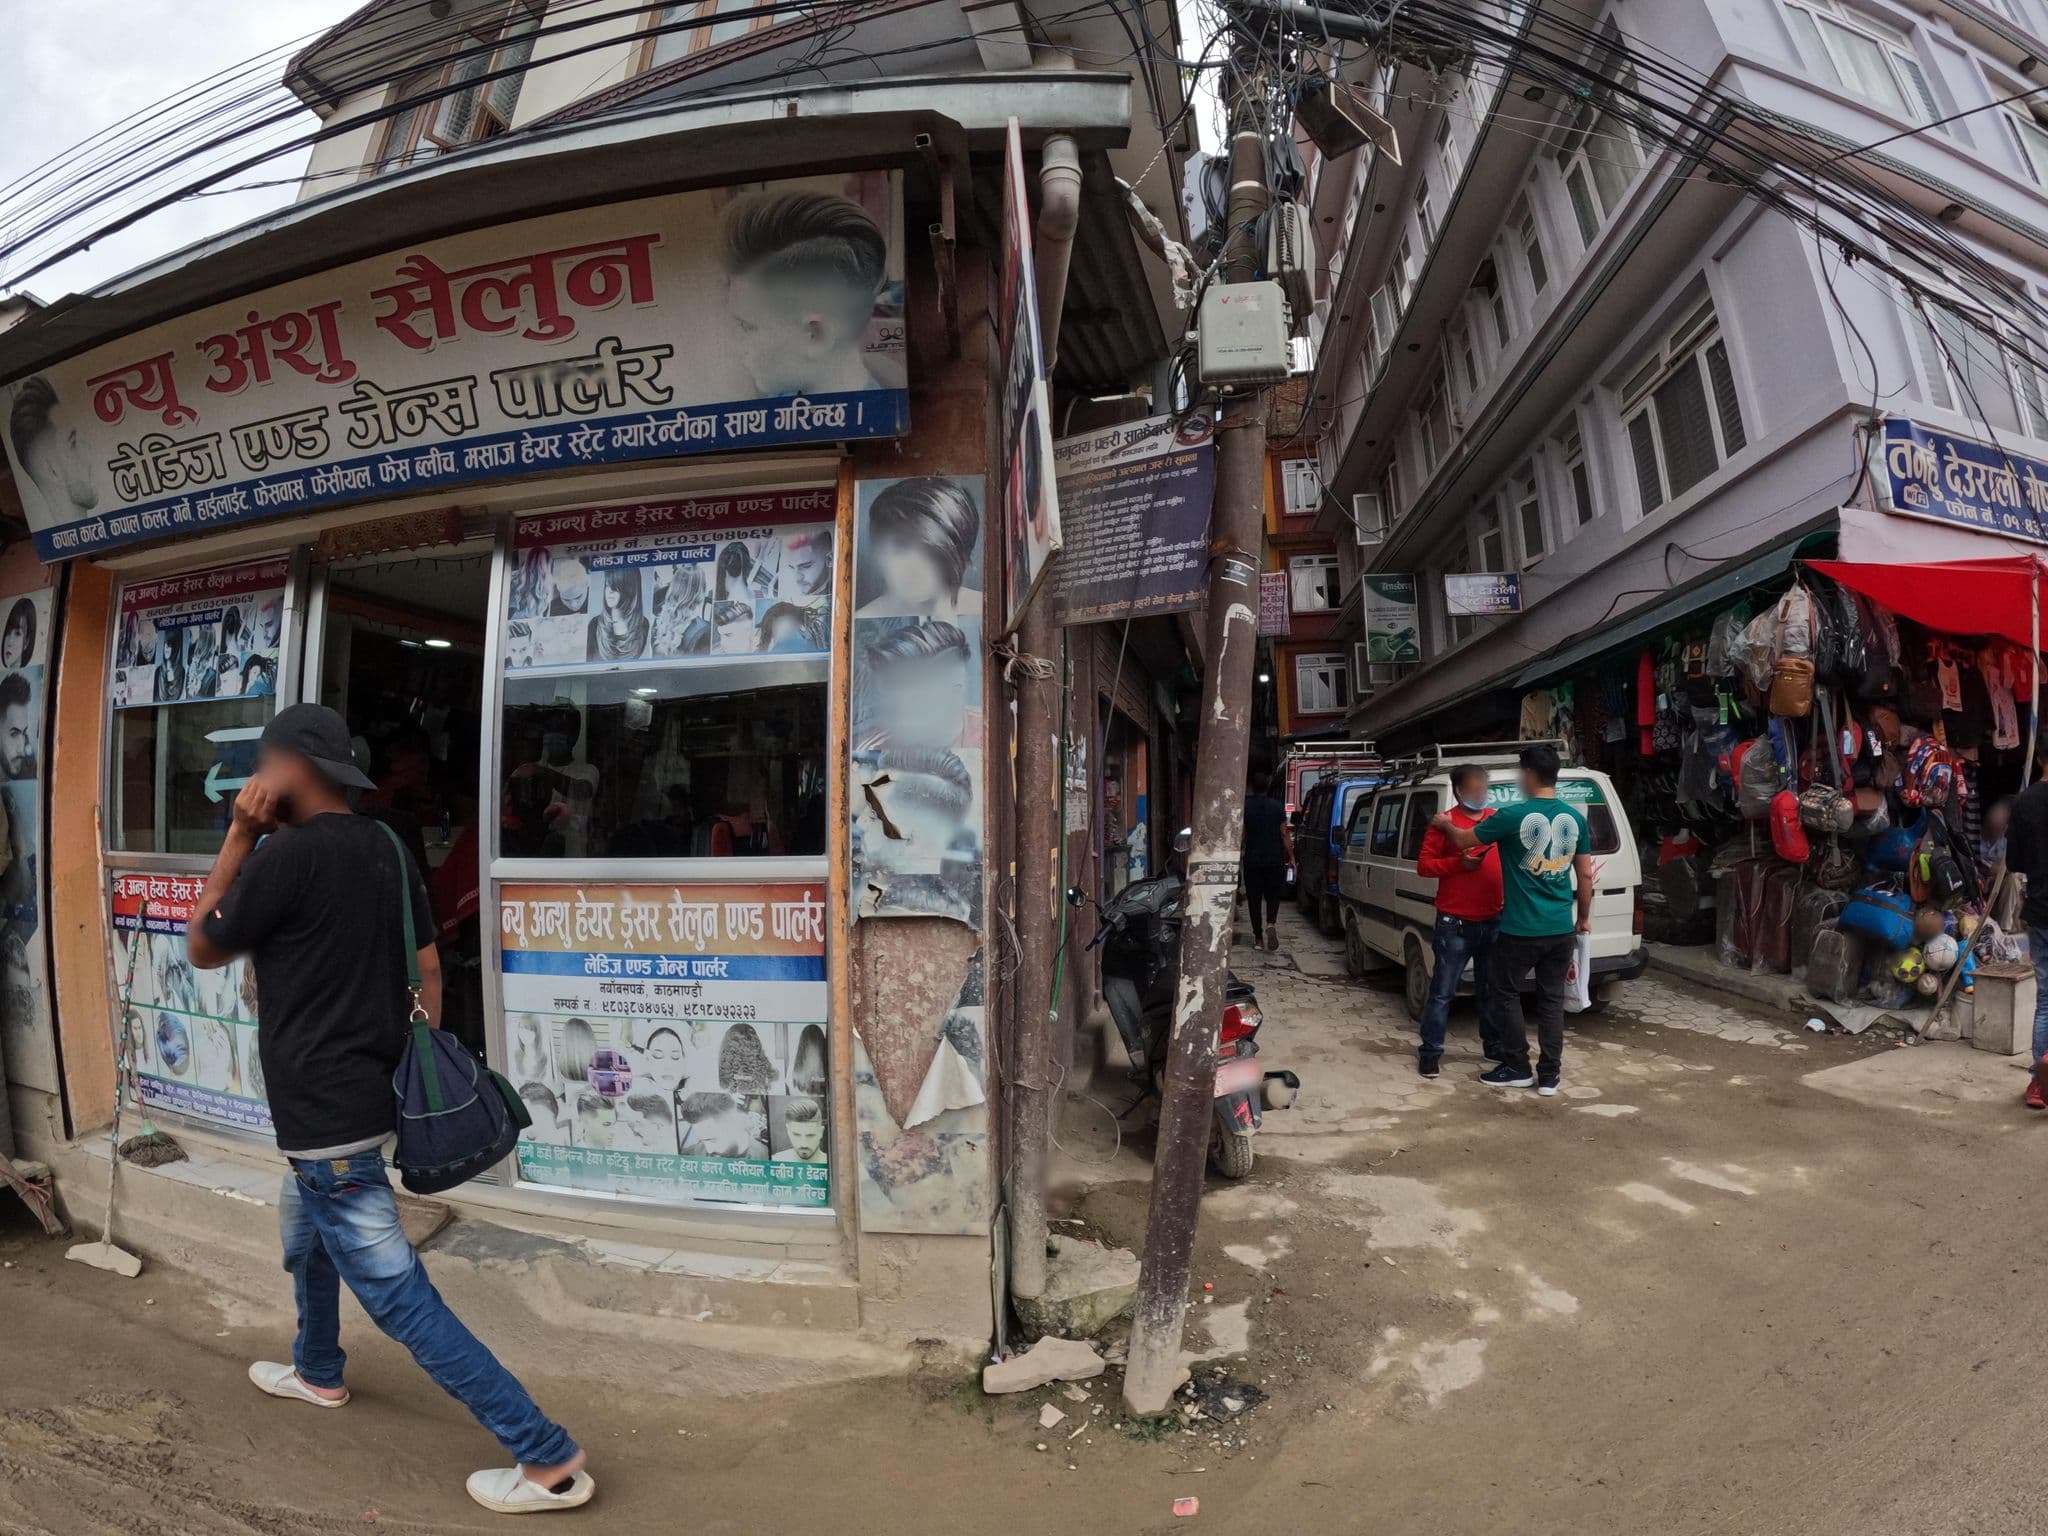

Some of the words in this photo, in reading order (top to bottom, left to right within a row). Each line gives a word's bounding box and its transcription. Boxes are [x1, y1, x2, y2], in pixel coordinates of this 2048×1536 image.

[87, 352, 199, 426] न्यू
[196, 310, 357, 395] अंशु
[370, 233, 661, 351] सैलुन
[109, 432, 227, 502] लेडिज
[231, 406, 331, 472] एण्ड
[340, 375, 478, 449] जेन्स
[493, 336, 674, 419] पार्लर
[52, 529, 81, 550] कपाल
[110, 514, 141, 536] कपाल
[142, 507, 171, 529] कलर
[378, 455, 411, 484] फेस
[464, 440, 516, 471] मसाज
[521, 431, 561, 464] हेयर
[567, 424, 606, 462] स्ट्रेट
[612, 410, 719, 449] ग्यारेन्टीका
[723, 409, 768, 439] साथ
[774, 396, 849, 431] गरिन्छ
[1943, 443, 2022, 508] देउराली
[518, 519, 544, 537] न्यू
[546, 515, 587, 533] अन्शु
[591, 509, 630, 529] हेयर
[634, 505, 676, 526] ड्रेसर
[681, 499, 731, 520] सैलुन
[736, 498, 776, 514] एण्ड
[781, 491, 833, 510] पार्लर
[1944, 498, 1979, 521] फोन
[1488, 787, 1522, 804] SUZ
[127, 879, 149, 901] अन्शु
[150, 876, 169, 899] हेयर
[171, 878, 192, 903] ड्रेसर
[501, 901, 529, 949] न्यू
[529, 901, 573, 950] अन्शु
[575, 888, 616, 943] हेयर
[619, 892, 663, 950] ड्रेसर
[725, 902, 766, 942] एण्ड
[771, 889, 826, 943] पार्लर
[584, 953, 622, 976] लेडिज
[625, 958, 653, 976] एण्ड
[655, 955, 688, 977] जेन्स
[692, 956, 729, 978] पार्लर
